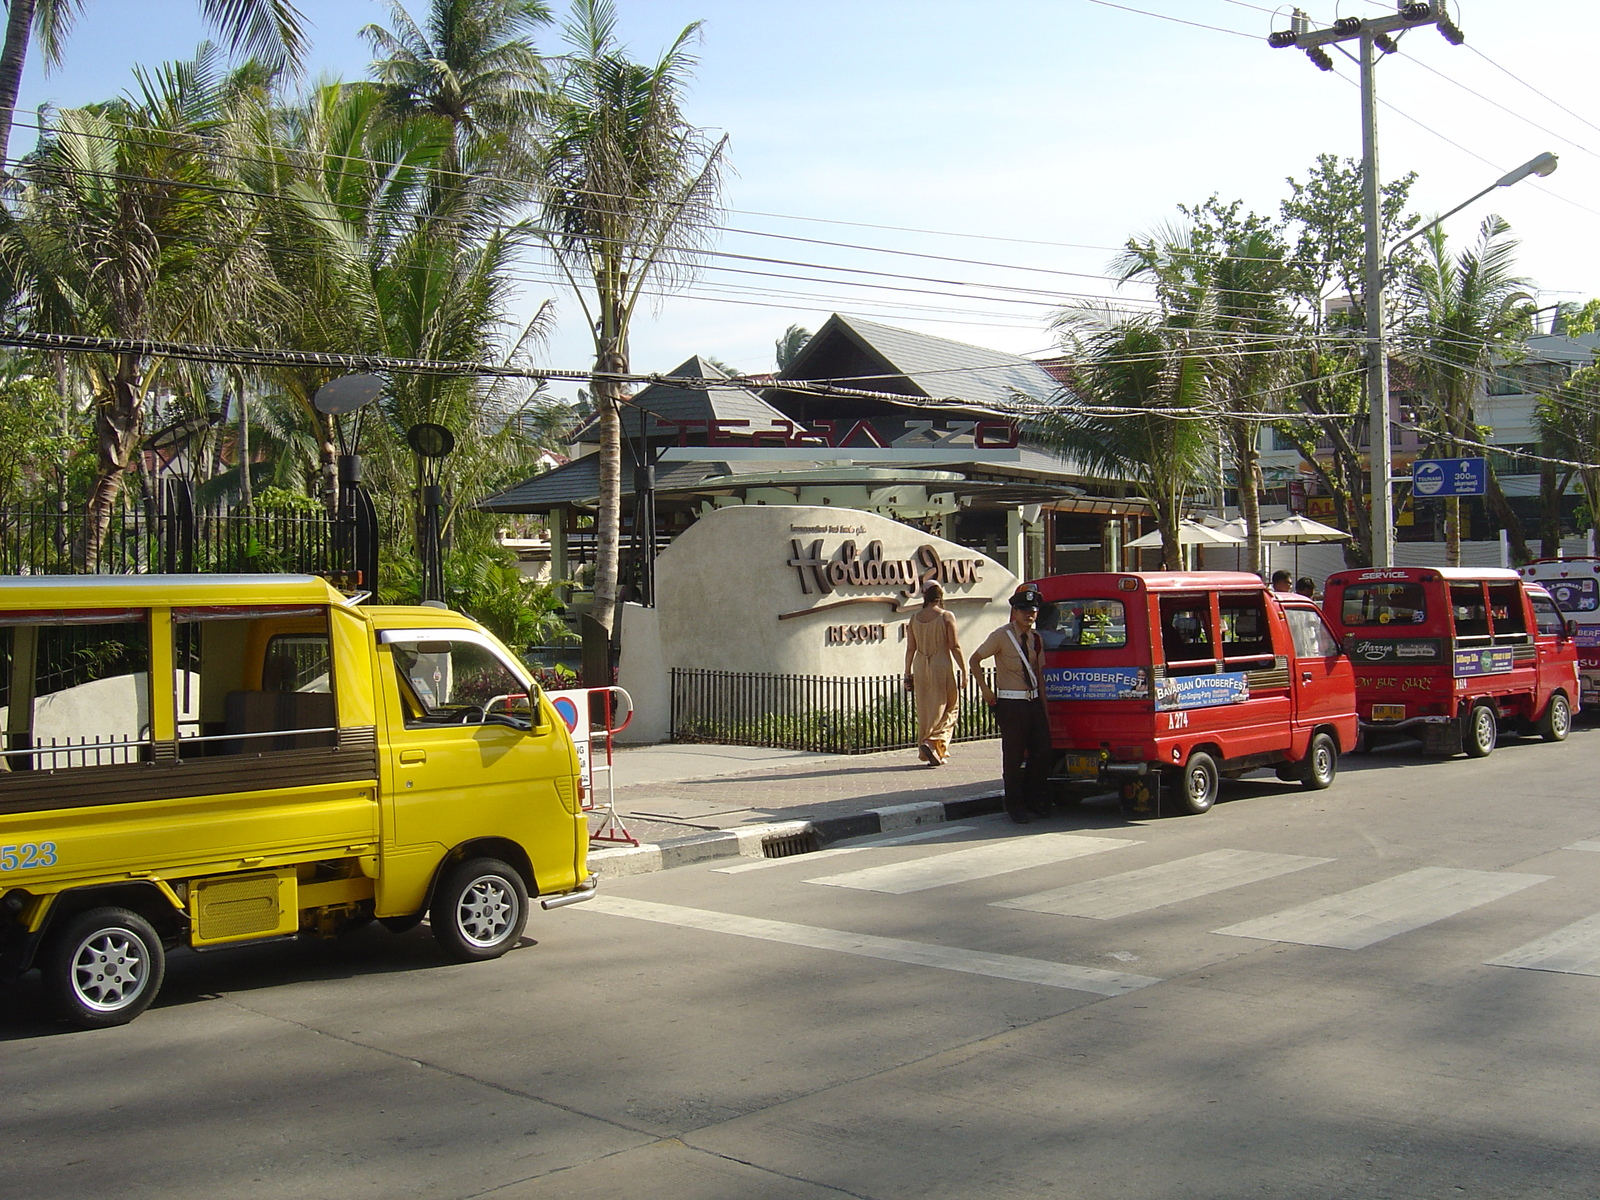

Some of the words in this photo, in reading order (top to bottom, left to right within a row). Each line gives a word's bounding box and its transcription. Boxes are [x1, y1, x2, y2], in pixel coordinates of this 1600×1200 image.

[787, 538, 920, 598] Holiday
[917, 544, 985, 584] Inn
[1358, 571, 1409, 580] SERVICE
[828, 622, 889, 642] RESORT
[1580, 658, 1598, 667] SU
[0, 841, 58, 872] 523
